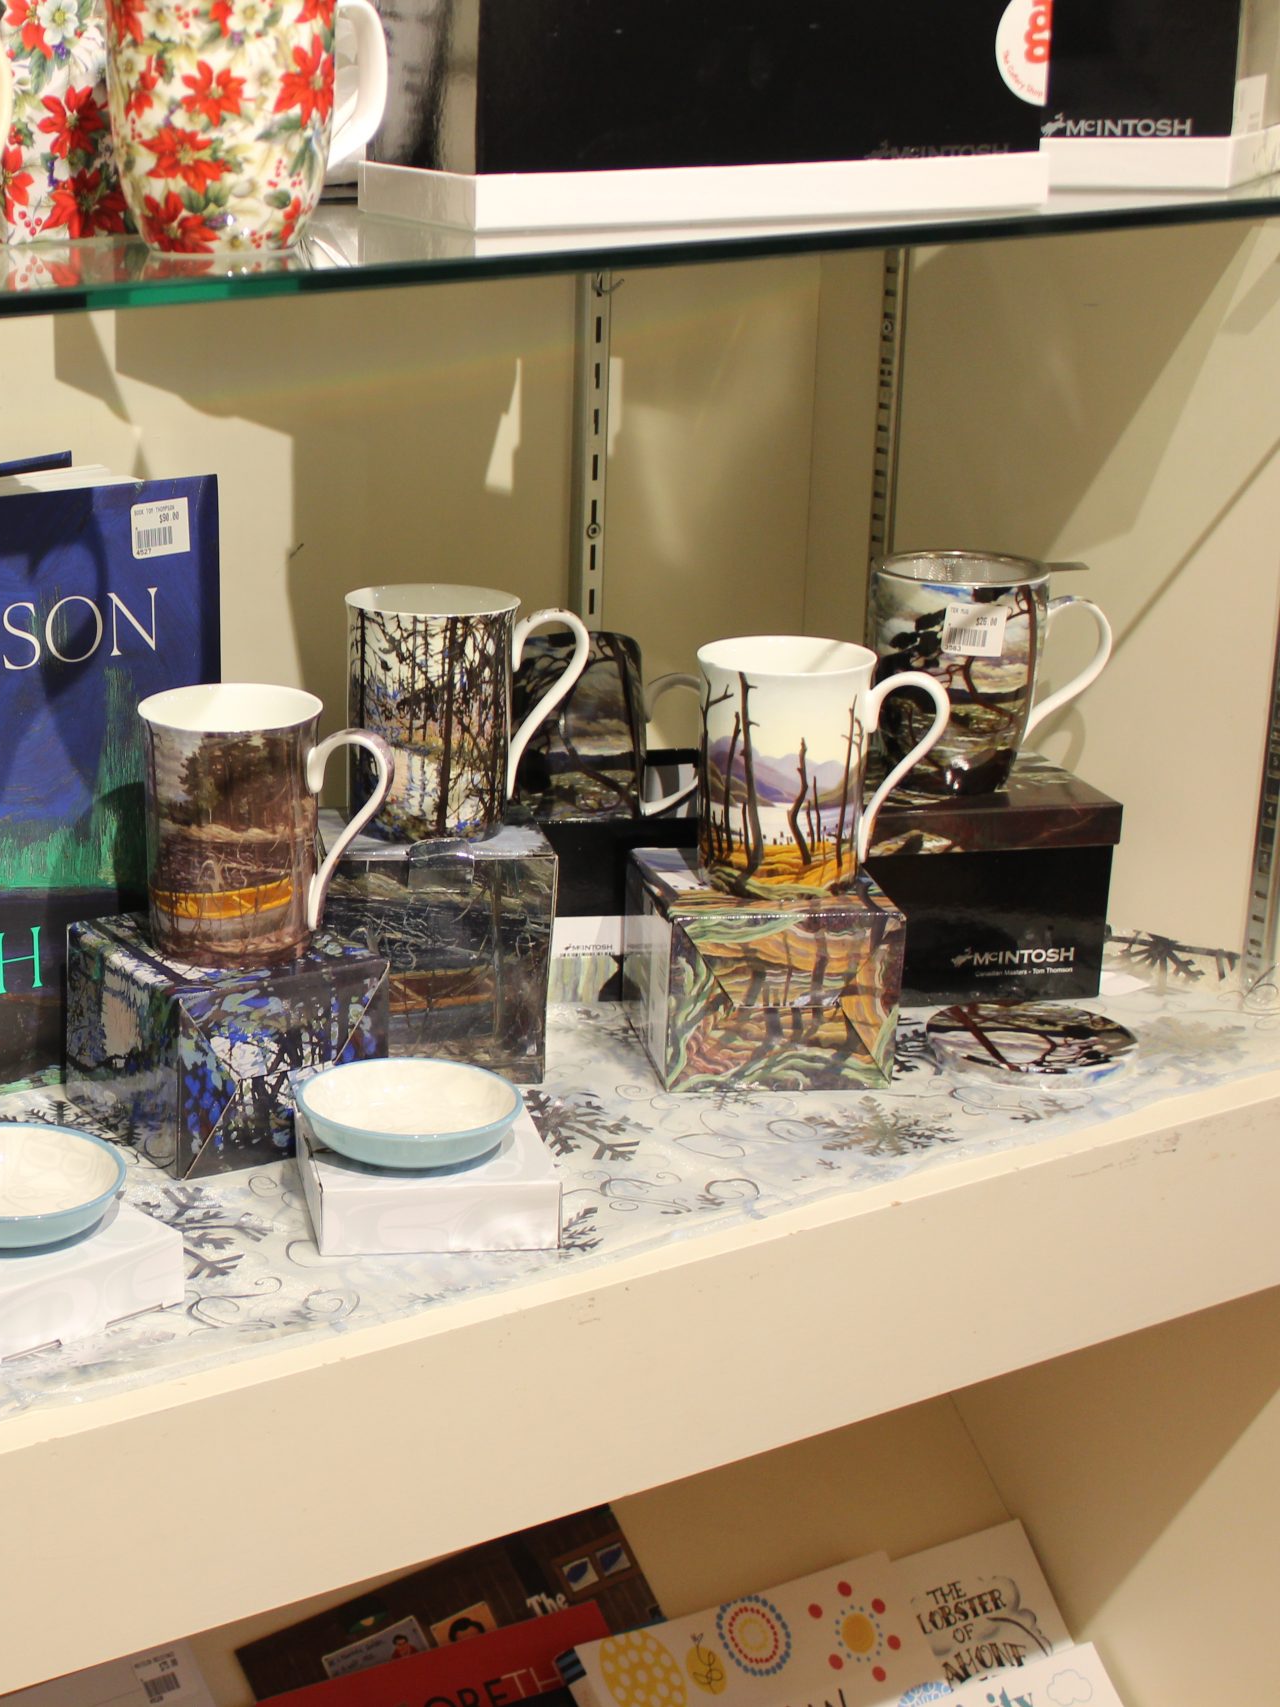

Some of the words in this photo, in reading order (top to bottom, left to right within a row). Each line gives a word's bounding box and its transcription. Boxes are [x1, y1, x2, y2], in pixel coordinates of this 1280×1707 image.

[1032, 967, 1045, 975] Tom
[1047, 966, 1073, 974] Thomson
[526, 1591, 569, 1617] The
[926, 1581, 966, 1605] THE
[916, 1588, 1007, 1635] LOBSTER
[952, 1623, 974, 1643] OF
